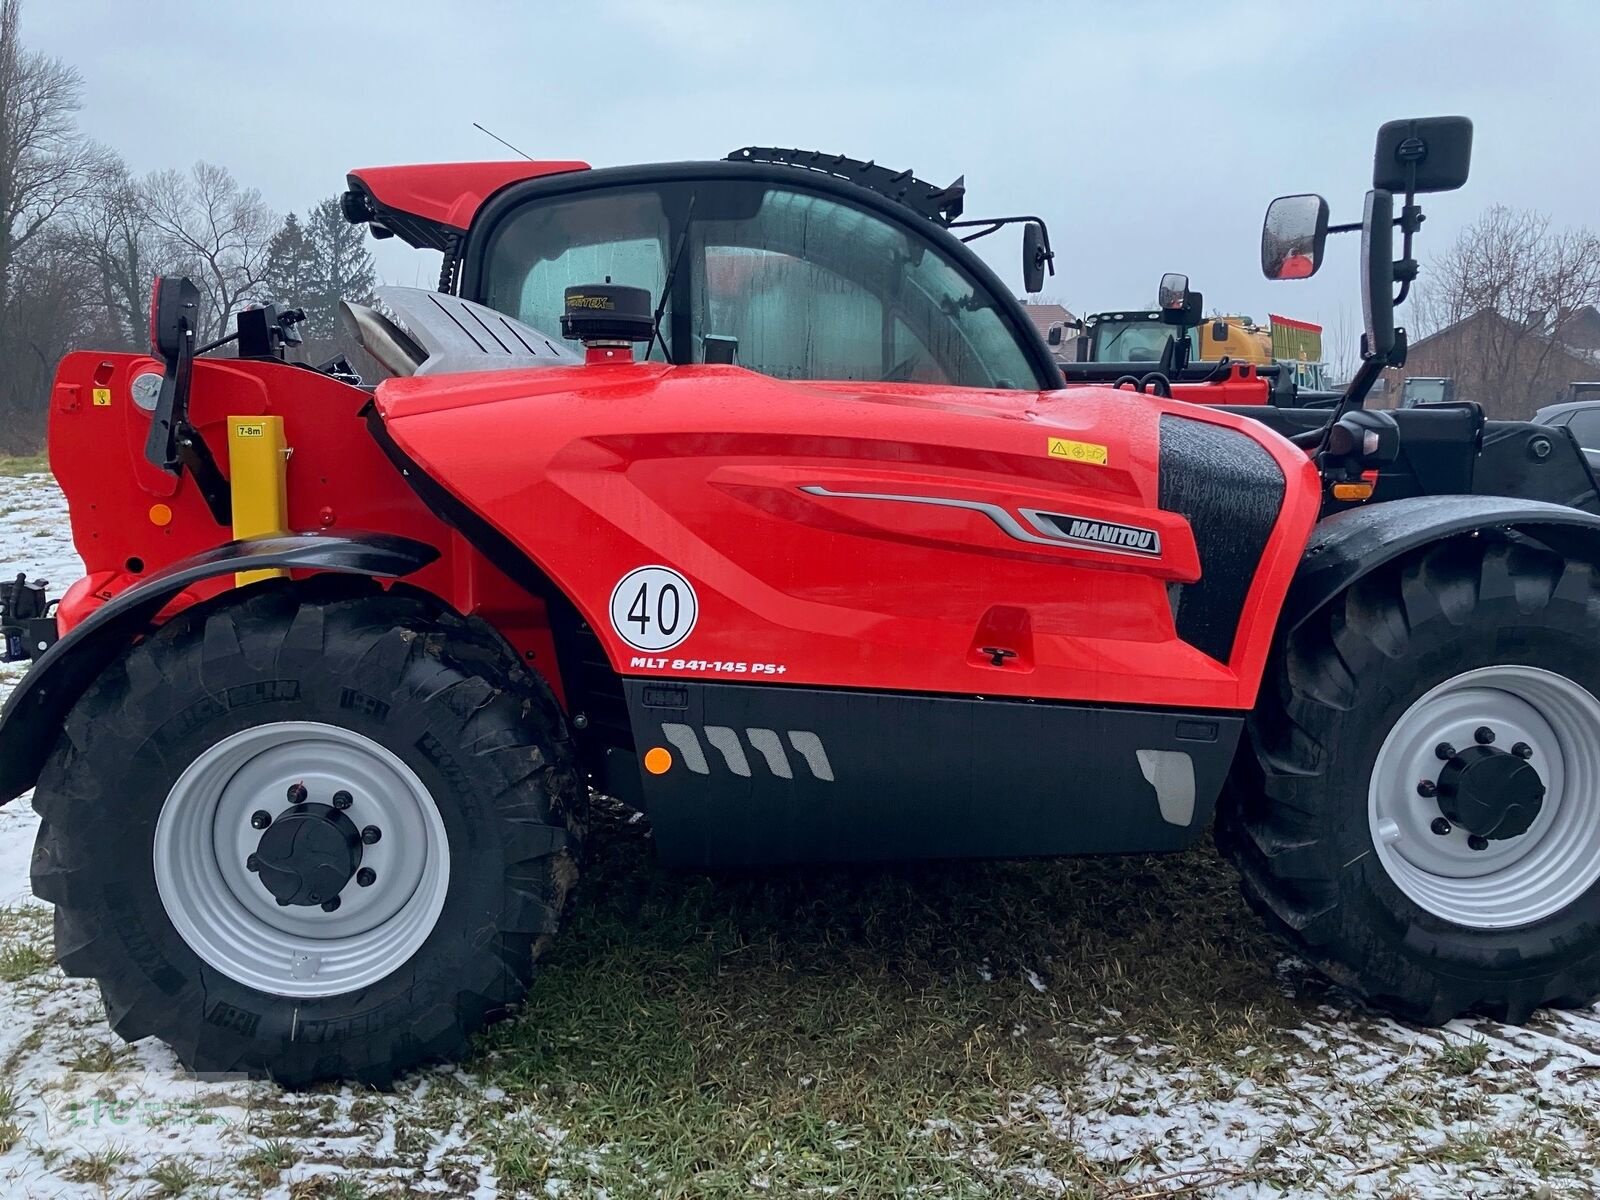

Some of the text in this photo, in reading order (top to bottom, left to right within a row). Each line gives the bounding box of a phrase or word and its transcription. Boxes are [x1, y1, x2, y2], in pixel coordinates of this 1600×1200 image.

[239, 427, 261, 435] 7-8m
[1069, 520, 1152, 548] MANITOU
[627, 582, 680, 636] 40
[630, 657, 787, 674] MLT 841-145 PS+
